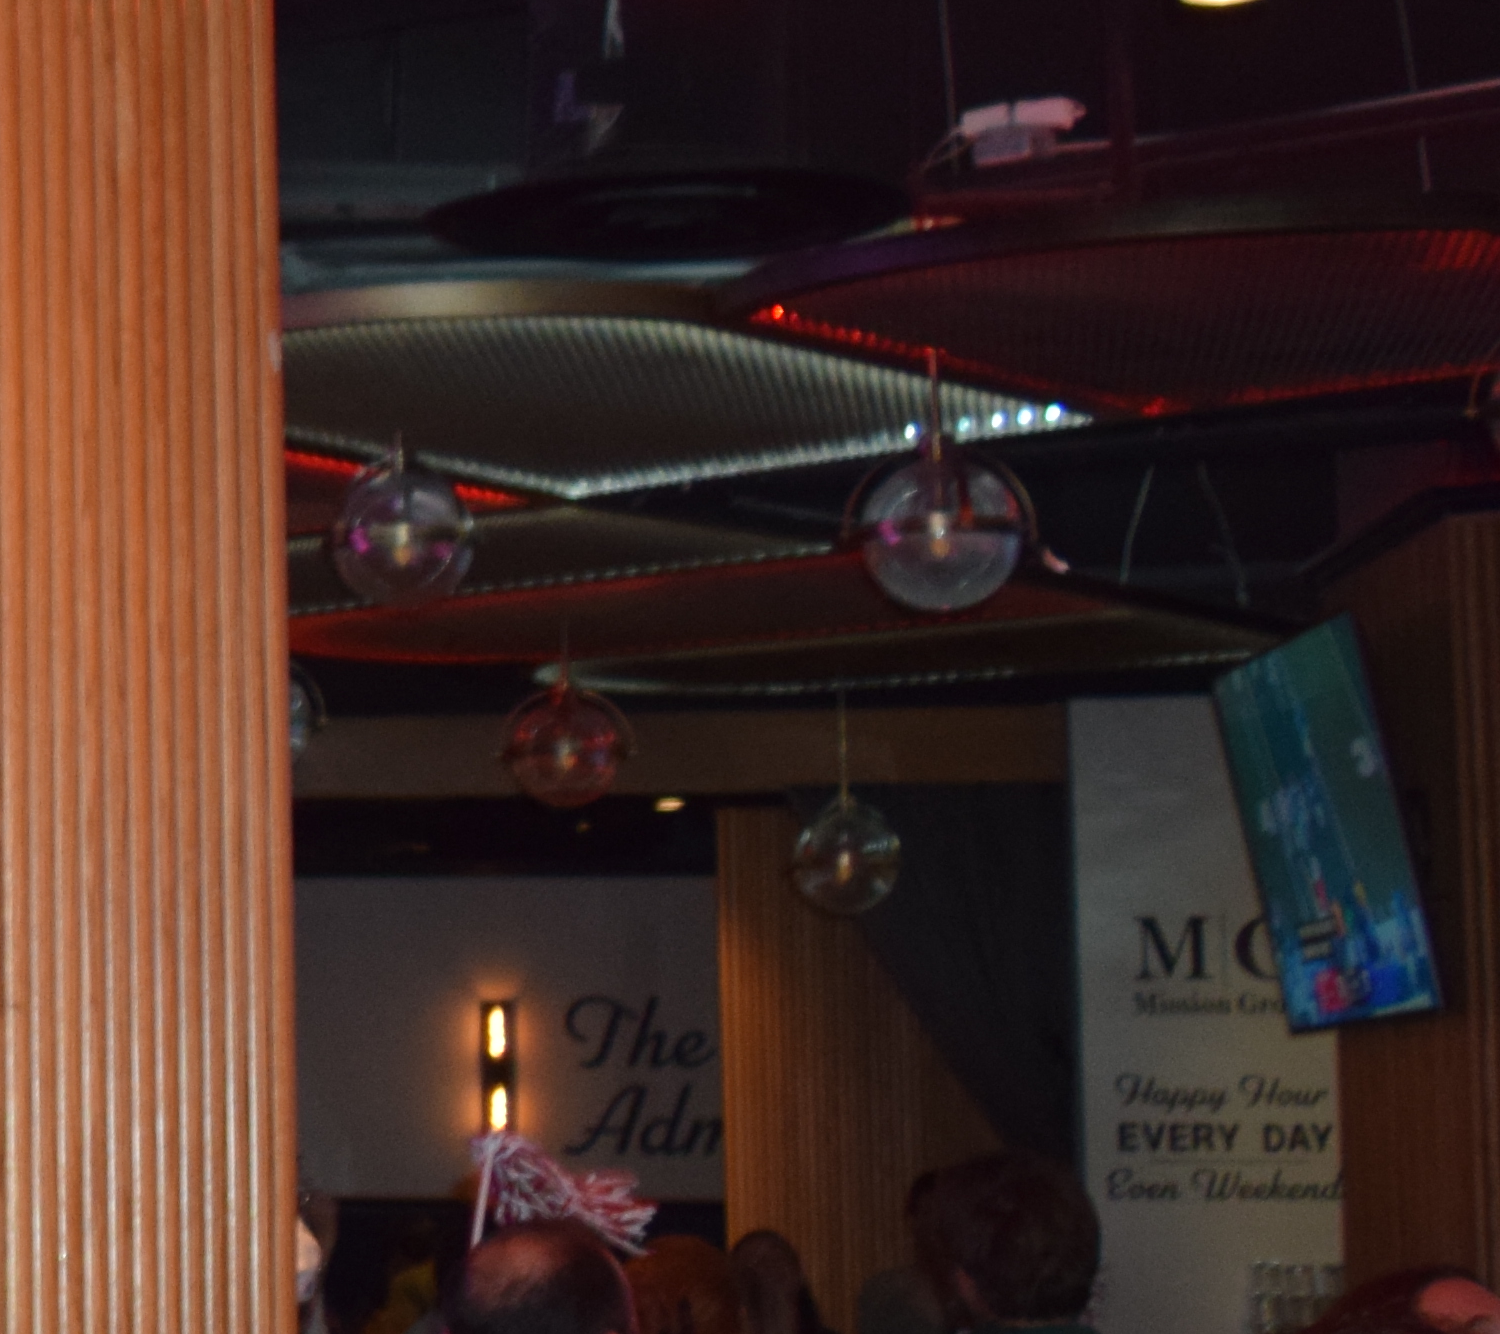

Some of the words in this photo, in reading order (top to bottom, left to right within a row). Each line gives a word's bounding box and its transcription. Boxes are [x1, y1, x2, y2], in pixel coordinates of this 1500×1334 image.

[563, 994, 716, 1069] The
[1113, 1071, 1227, 1114] Happy
[1237, 1072, 1330, 1109] Hour
[1116, 1122, 1240, 1154] EVERY
[1262, 1123, 1333, 1154] DAY
[1105, 1167, 1181, 1202] Even
